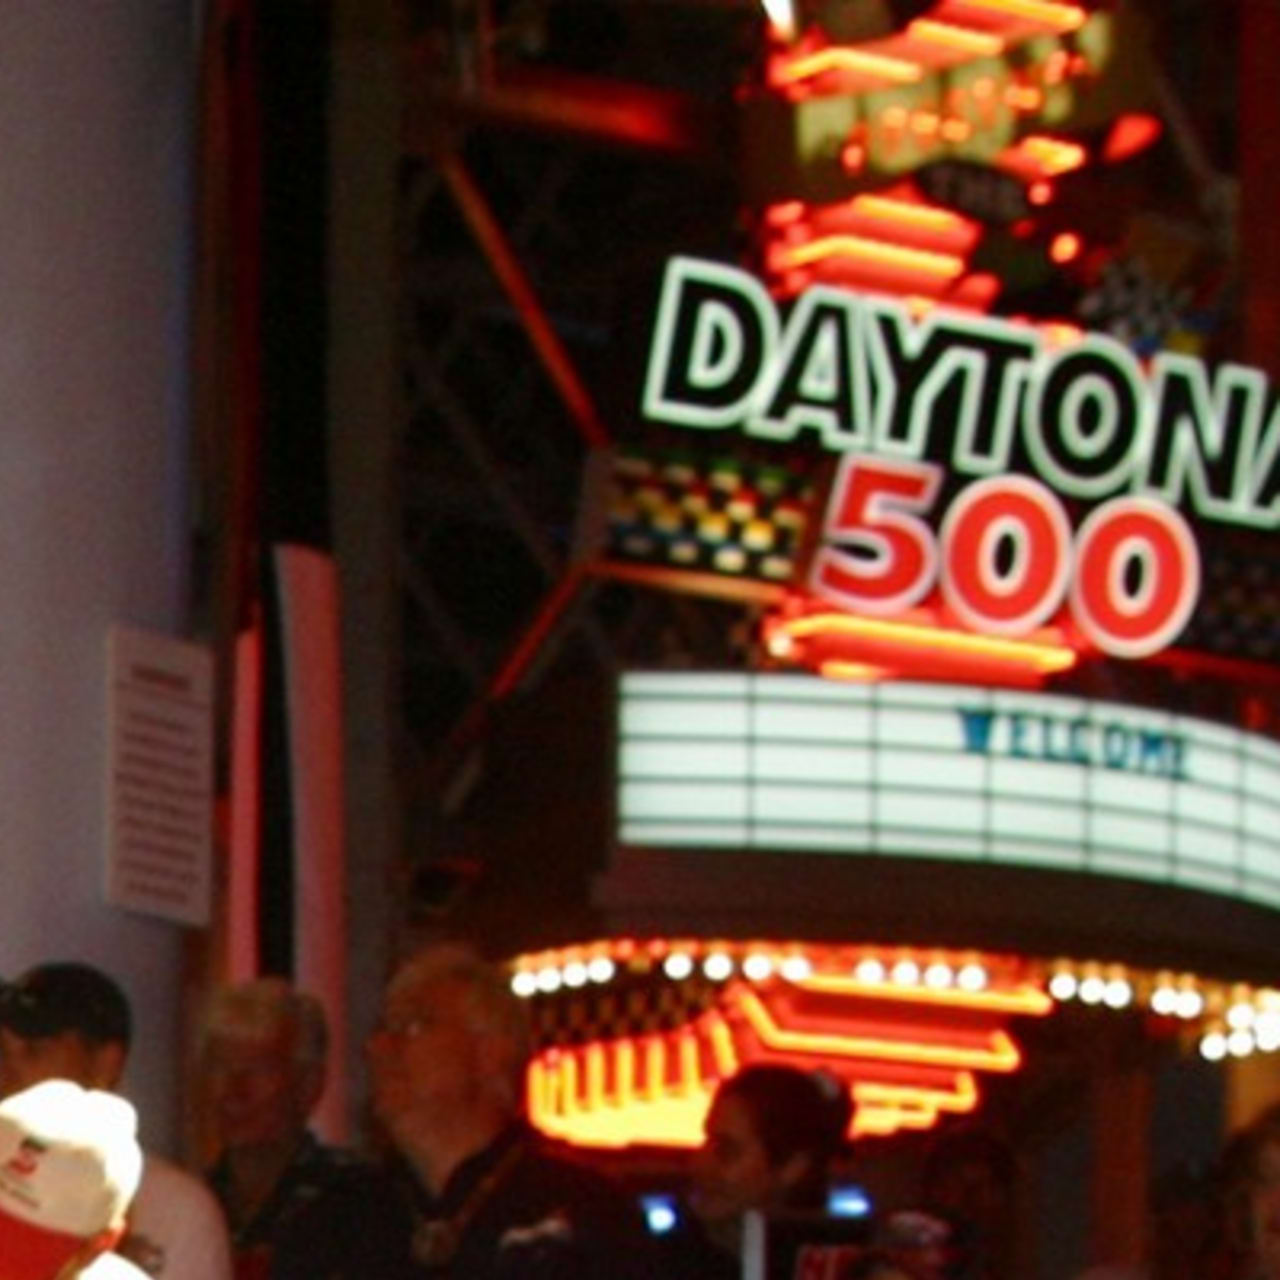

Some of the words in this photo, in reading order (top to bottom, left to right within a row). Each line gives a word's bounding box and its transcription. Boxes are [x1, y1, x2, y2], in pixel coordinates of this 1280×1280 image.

[644, 255, 1280, 530] DAYTON
[810, 453, 1201, 659] 500
[956, 706, 1188, 780] WELCOME
